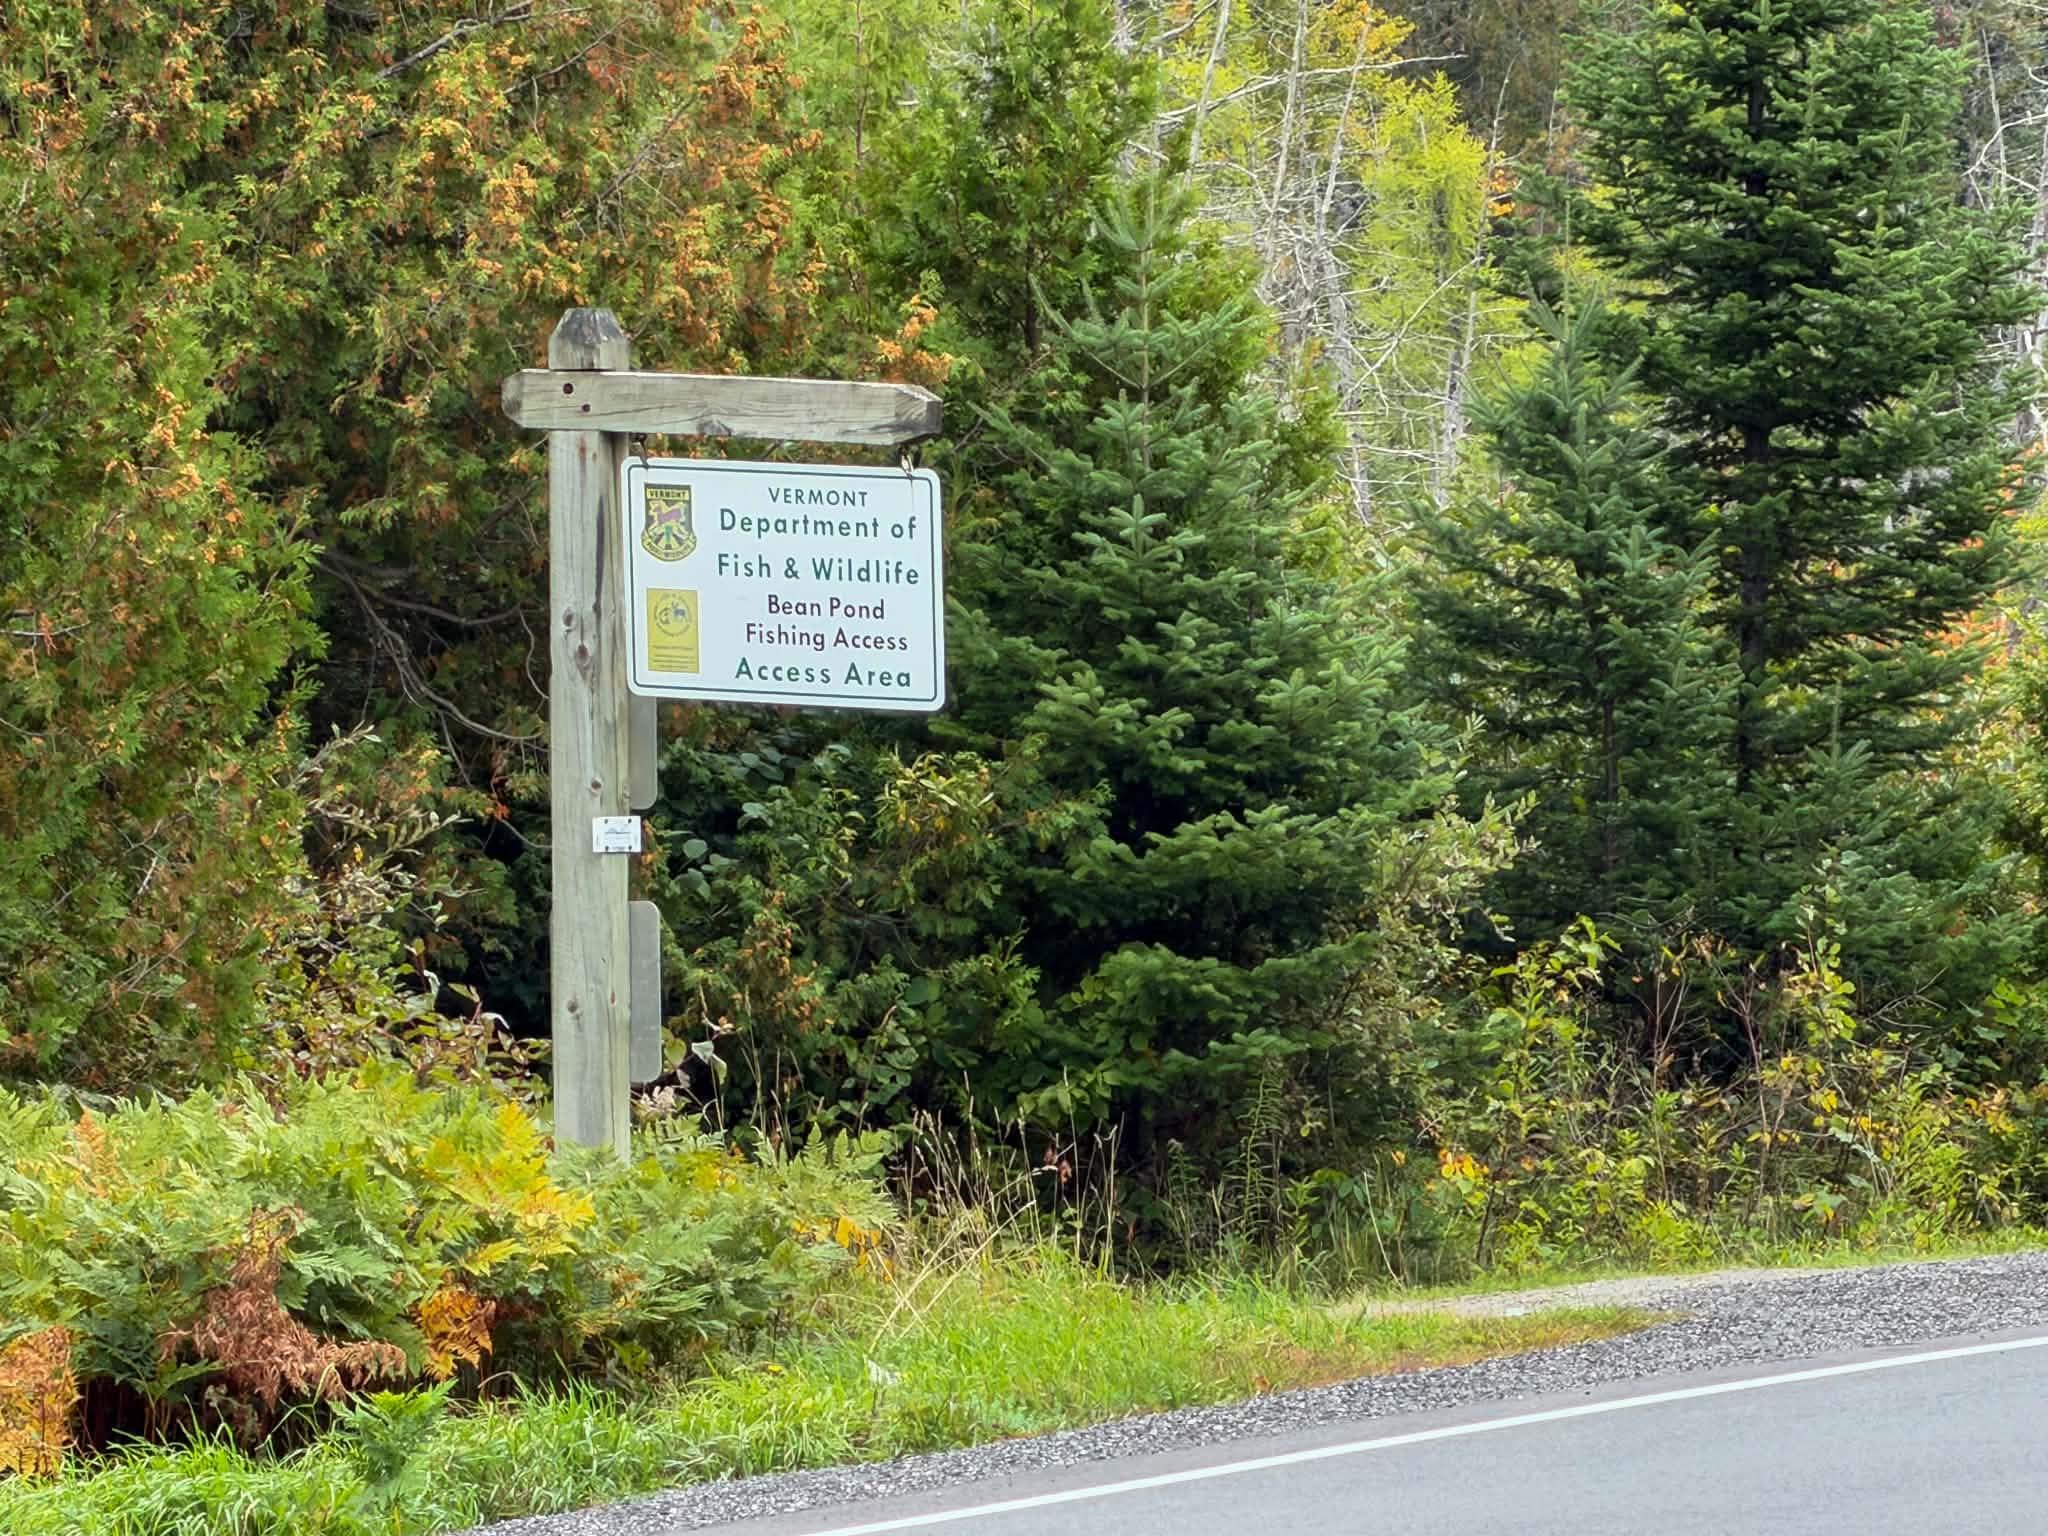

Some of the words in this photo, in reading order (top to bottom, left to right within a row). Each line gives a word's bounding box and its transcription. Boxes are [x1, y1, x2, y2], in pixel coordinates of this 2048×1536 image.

[768, 487, 868, 507] VERMONT
[720, 508, 879, 539] Department
[890, 516, 917, 539] of
[718, 553, 772, 579] Fish
[784, 557, 800, 580] &
[812, 557, 920, 585] Wildlife
[767, 594, 822, 617] Bean
[829, 597, 885, 620] Pond
[746, 623, 825, 651] Fishing
[832, 627, 908, 651] Access
[735, 657, 831, 684] Access
[844, 662, 912, 687] Area
